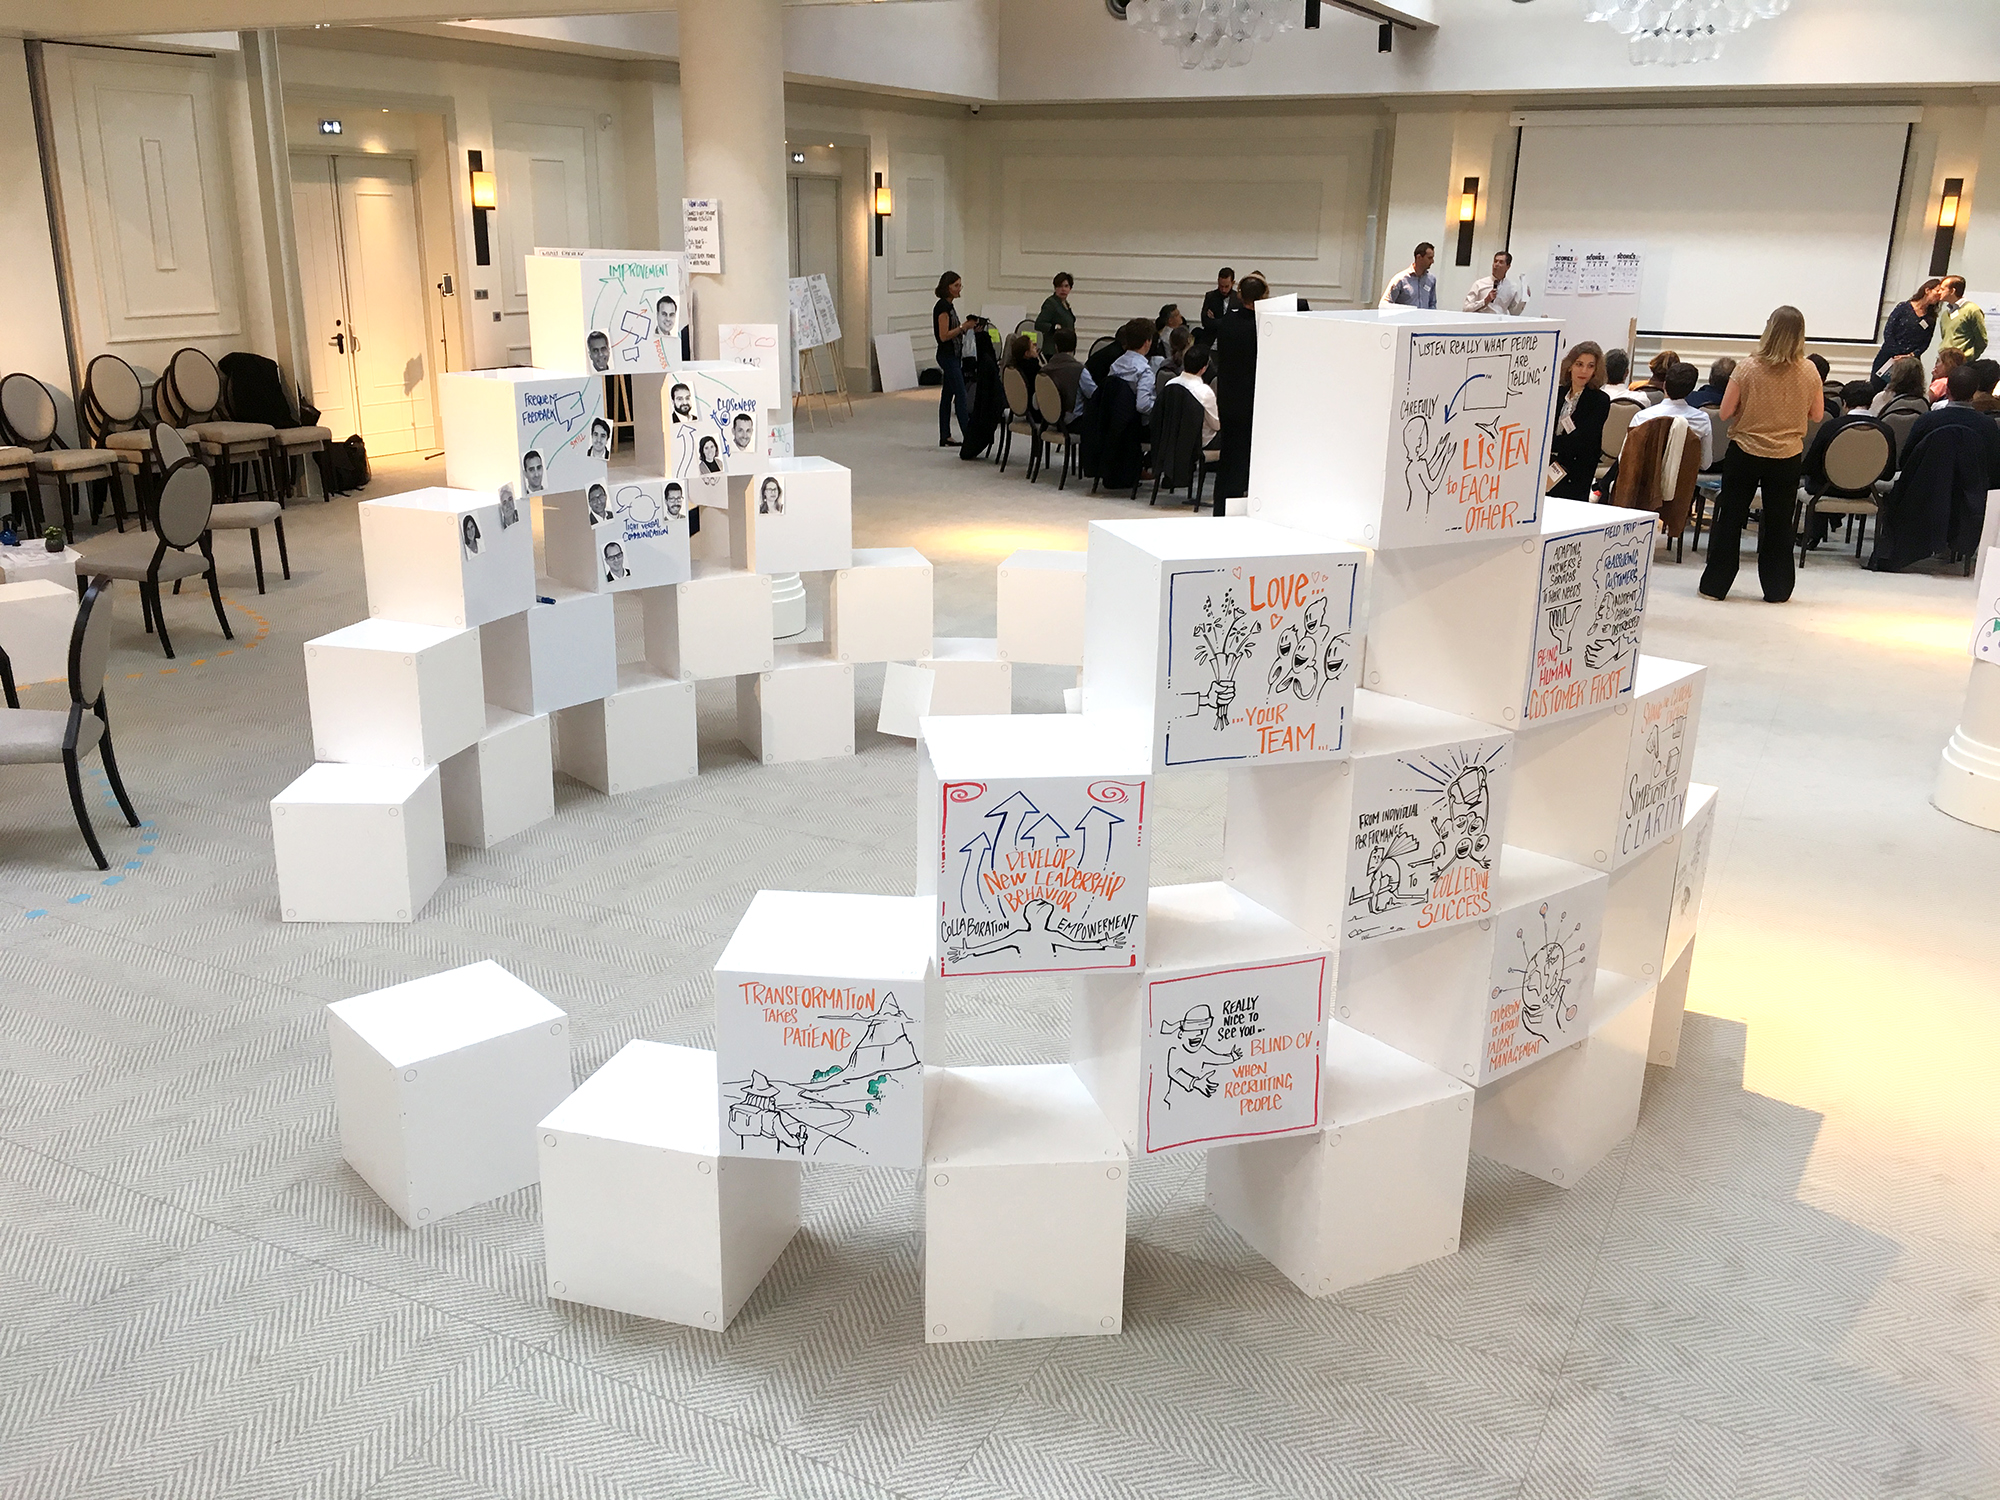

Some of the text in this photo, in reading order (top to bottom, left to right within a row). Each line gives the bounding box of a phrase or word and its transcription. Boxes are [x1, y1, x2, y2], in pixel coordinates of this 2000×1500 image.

[609, 263, 669, 281] IMPROVEMENT
[1484, 339, 1506, 352] WHAT
[1400, 394, 1439, 420] CAREFULLY
[1459, 473, 1500, 504] EACH
[1604, 522, 1637, 542] FIELD TRIP
[1548, 558, 1576, 574] ANSWERS
[1537, 644, 1558, 666] BEING
[1539, 658, 1572, 687] HUMAN
[1529, 666, 1626, 720] CUSTOMER FIRST
[1359, 803, 1419, 830] FROM INDIVIDUAL
[1622, 788, 1687, 855] CLARITY
[1005, 848, 1076, 871] DEVELOP
[1432, 866, 1491, 899] COLLECTIVE
[1417, 890, 1492, 929] SUCCESS
[940, 914, 1139, 943] COLLABORATION EMPOWERMENT
[738, 981, 876, 1011] TRANSFORMATION
[1222, 995, 1259, 1015] REALLY
[1248, 1012, 1259, 1023] TO
[1498, 1015, 1520, 1035] ABOUT
[1250, 1030, 1313, 1057] BLIND CV
[1486, 1032, 1515, 1058] TALENT
[1488, 1037, 1543, 1073] MANAGEMENT
[1224, 1073, 1293, 1098] RECRUITING
